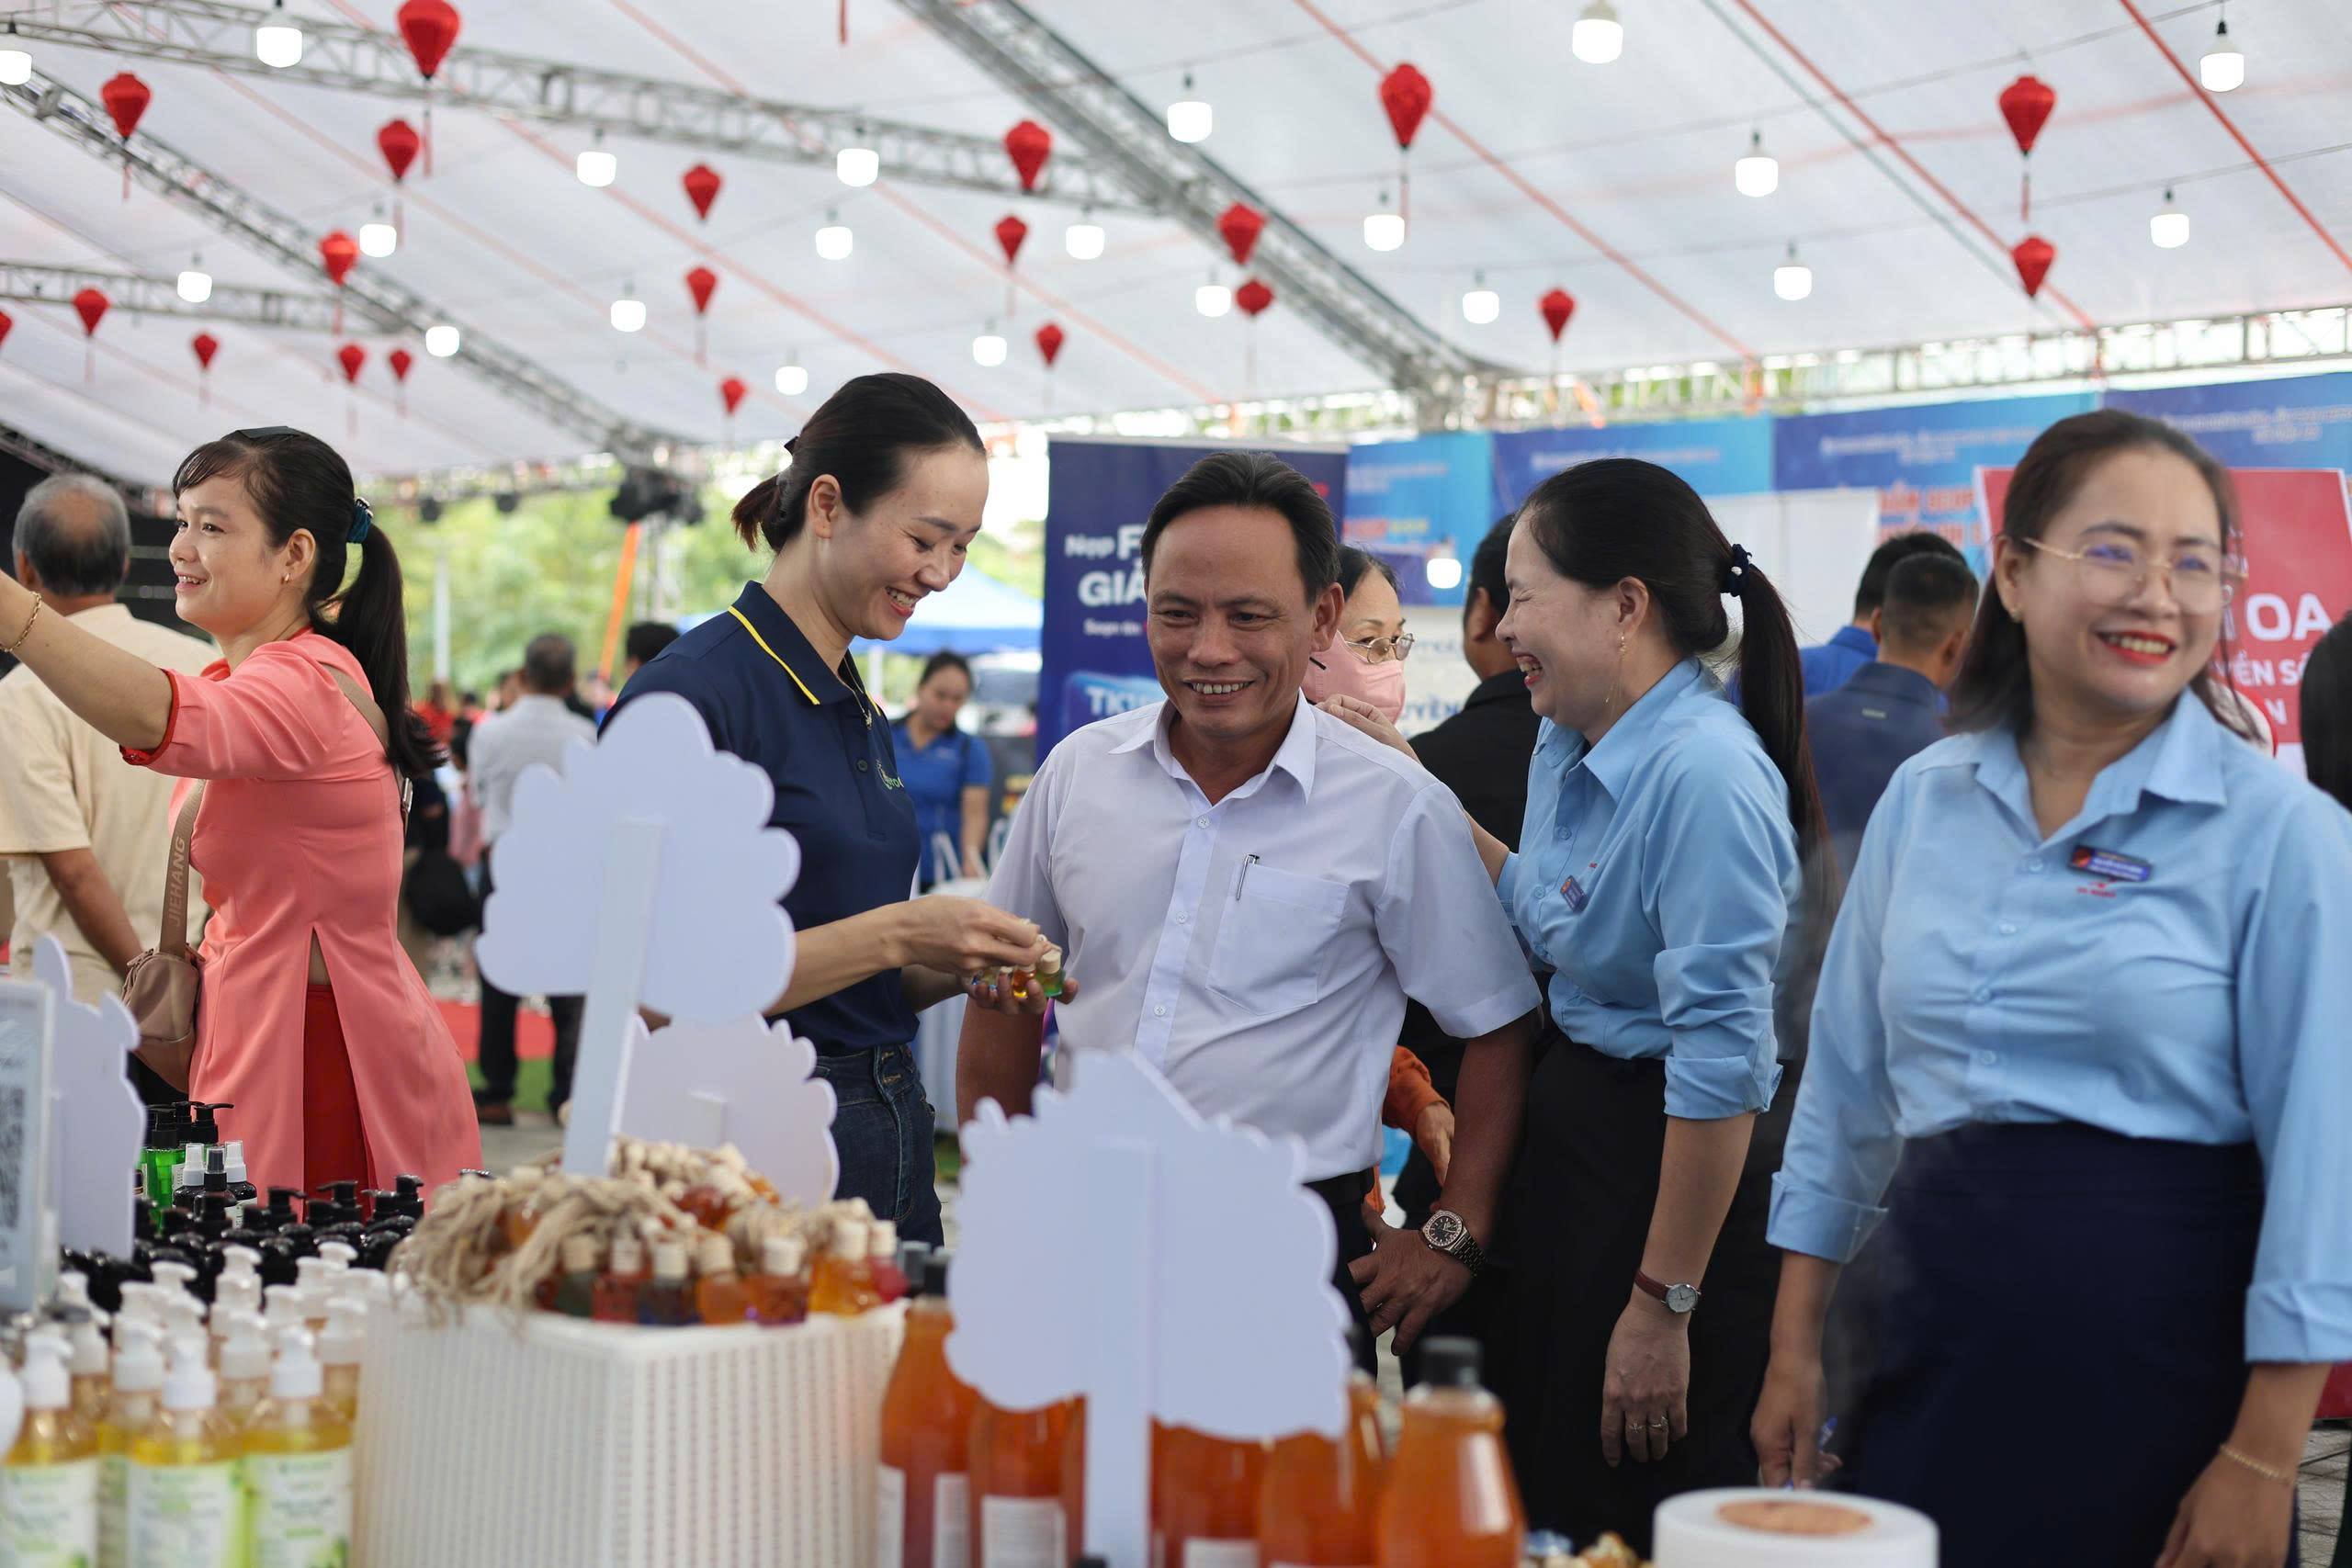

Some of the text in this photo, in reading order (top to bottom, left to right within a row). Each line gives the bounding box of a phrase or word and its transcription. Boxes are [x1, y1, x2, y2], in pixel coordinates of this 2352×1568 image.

[1116, 524, 1149, 560] F
[2222, 592, 2335, 642] OA
[167, 836, 186, 928] JIEHANG
